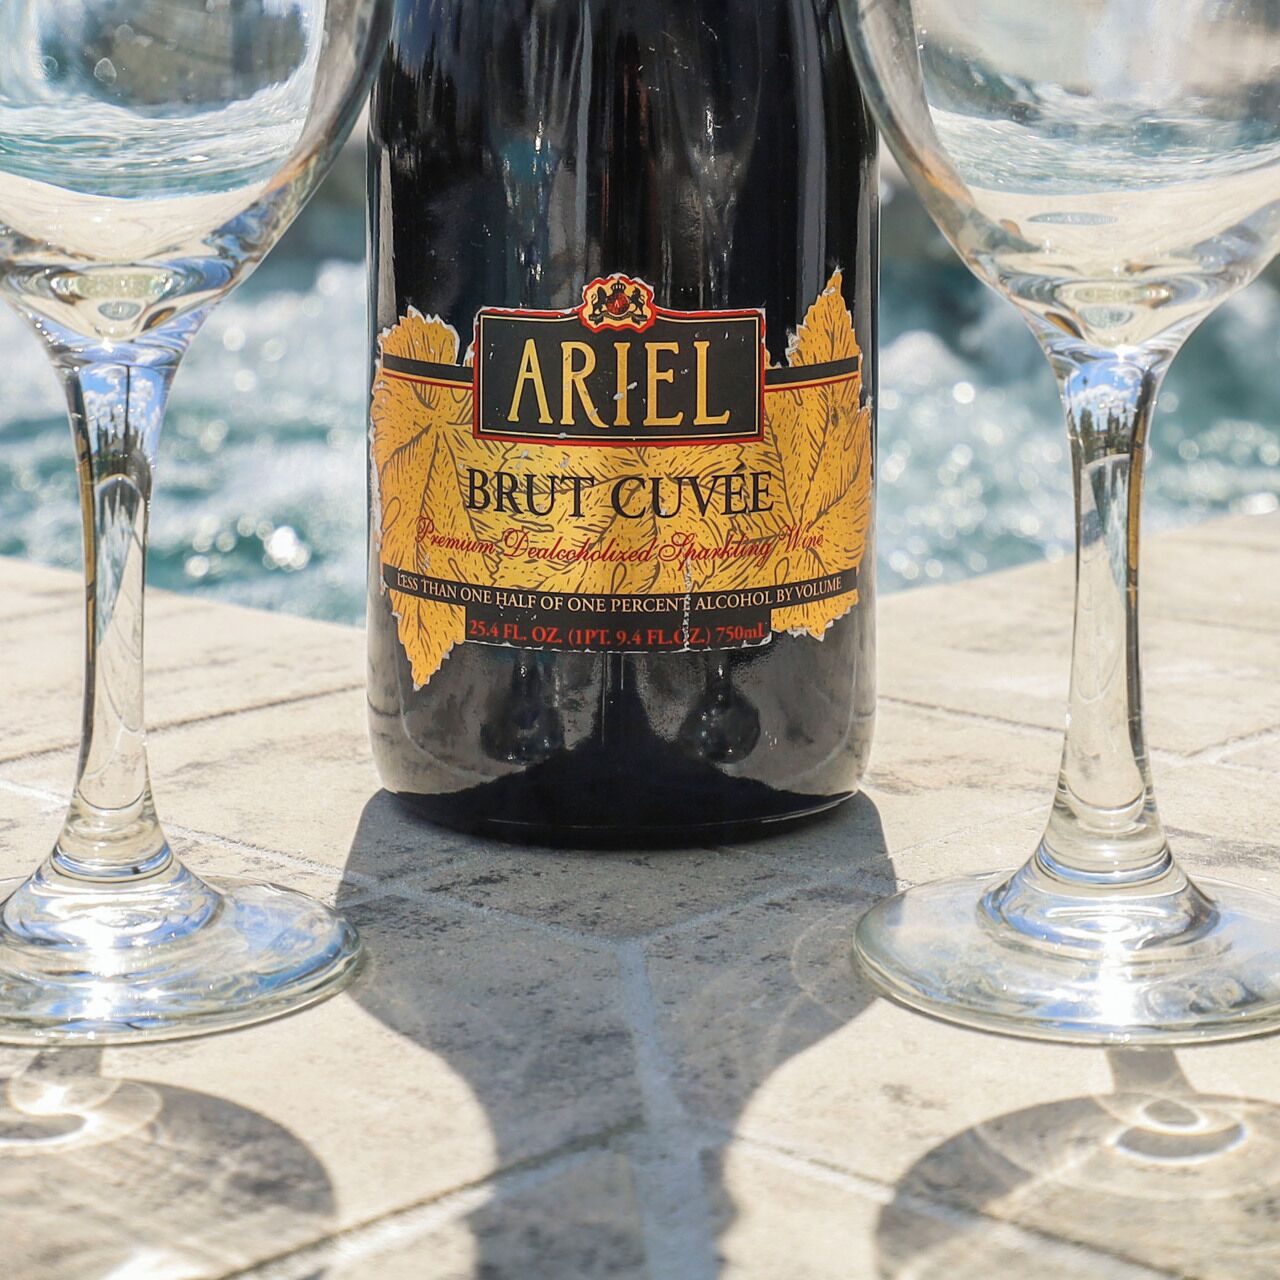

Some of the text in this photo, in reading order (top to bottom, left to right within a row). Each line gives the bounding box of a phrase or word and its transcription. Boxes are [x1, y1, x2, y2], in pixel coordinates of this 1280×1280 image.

[507, 338, 731, 429] ARIEL
[465, 462, 775, 518] BRUT CUVÉE
[414, 517, 824, 571] Premium Dealcoholized Sparkling Wine
[397, 571, 842, 613] LESS THAN ONE HALF OF ONE PERCENT ALCOHOL BY VOLUME
[470, 619, 499, 637] 25.4
[503, 623, 528, 640] FL.
[532, 627, 562, 643] OZ.
[568, 628, 612, 646] (1PT.
[616, 629, 642, 646] 9.4
[716, 622, 765, 641] 750mL
